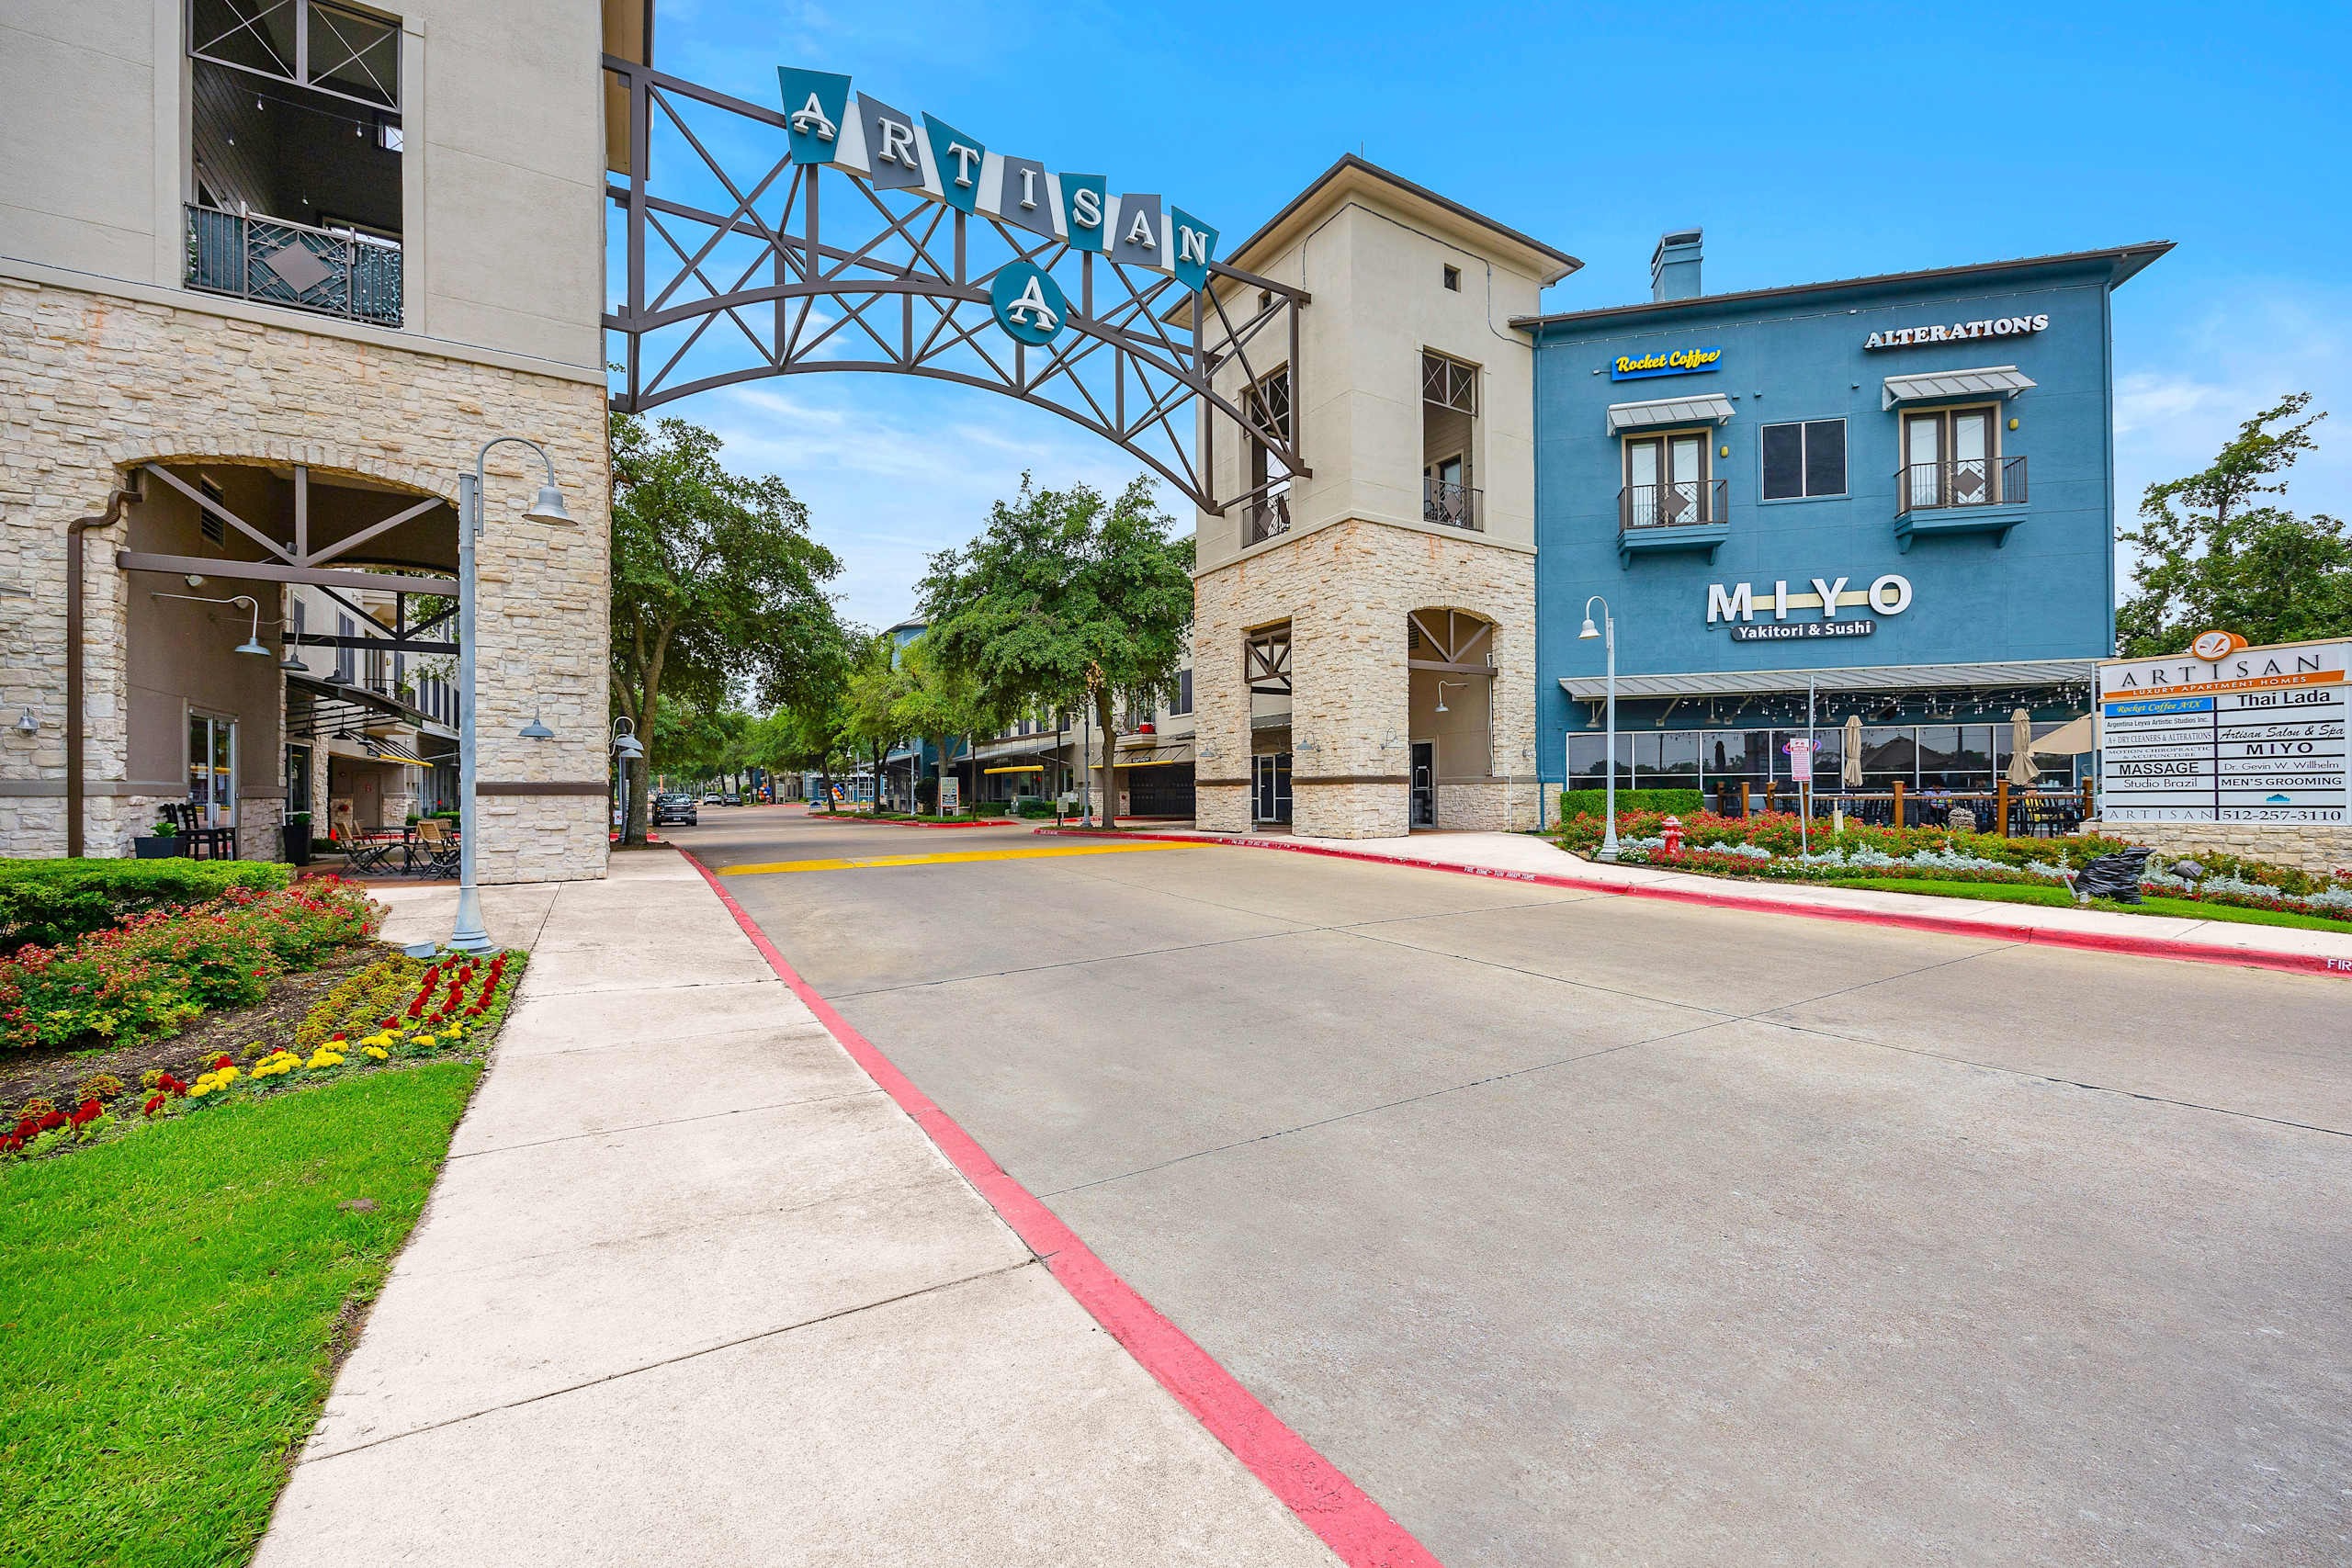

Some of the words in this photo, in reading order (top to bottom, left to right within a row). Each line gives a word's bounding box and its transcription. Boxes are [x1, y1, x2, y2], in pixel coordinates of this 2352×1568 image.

[790, 92, 1209, 266] ARTISAN
[1006, 275, 1059, 332] A
[1864, 314, 2049, 348] ALTERATIONS
[1616, 354, 1668, 372] Rocket
[1668, 349, 1721, 369] Coffee
[1707, 574, 1913, 623] MIYO
[1738, 625, 1804, 639] Yakitori
[1808, 624, 1821, 636] &
[1825, 621, 1871, 635] Sushi
[2121, 654, 2321, 687] ARTISAN
[2132, 687, 2175, 695] LUXURY
[2181, 681, 2254, 692] APARTMENT
[2260, 676, 2307, 685] HOMES
[2237, 693, 2277, 706] Thai
[2284, 690, 2331, 704] Lada
[2117, 704, 2145, 713] Rocket
[2148, 702, 2177, 713] Coffee
[2177, 700, 2203, 709] ATX
[2107, 720, 2133, 728] Argentina
[2134, 719, 2151, 728] Leyva
[2131, 734, 2162, 743] CLEANERS
[2167, 731, 2211, 740] ALTERATIONS
[2219, 728, 2262, 739] Artisan
[2266, 727, 2301, 738] Salon
[2304, 725, 2314, 736] &
[2319, 724, 2345, 738] Spa
[2246, 742, 2313, 755] MIYO
[2120, 762, 2199, 774] MASSAGE
[2124, 777, 2160, 788] Studio
[2164, 777, 2198, 787] Brazil
[2221, 778, 2263, 786] MEN'S
[2266, 777, 2342, 785] GROOMING
[2109, 810, 2212, 819] ARTISAN
[2222, 810, 2341, 820] 512-257-3110
[2327, 958, 2352, 971] FIR
